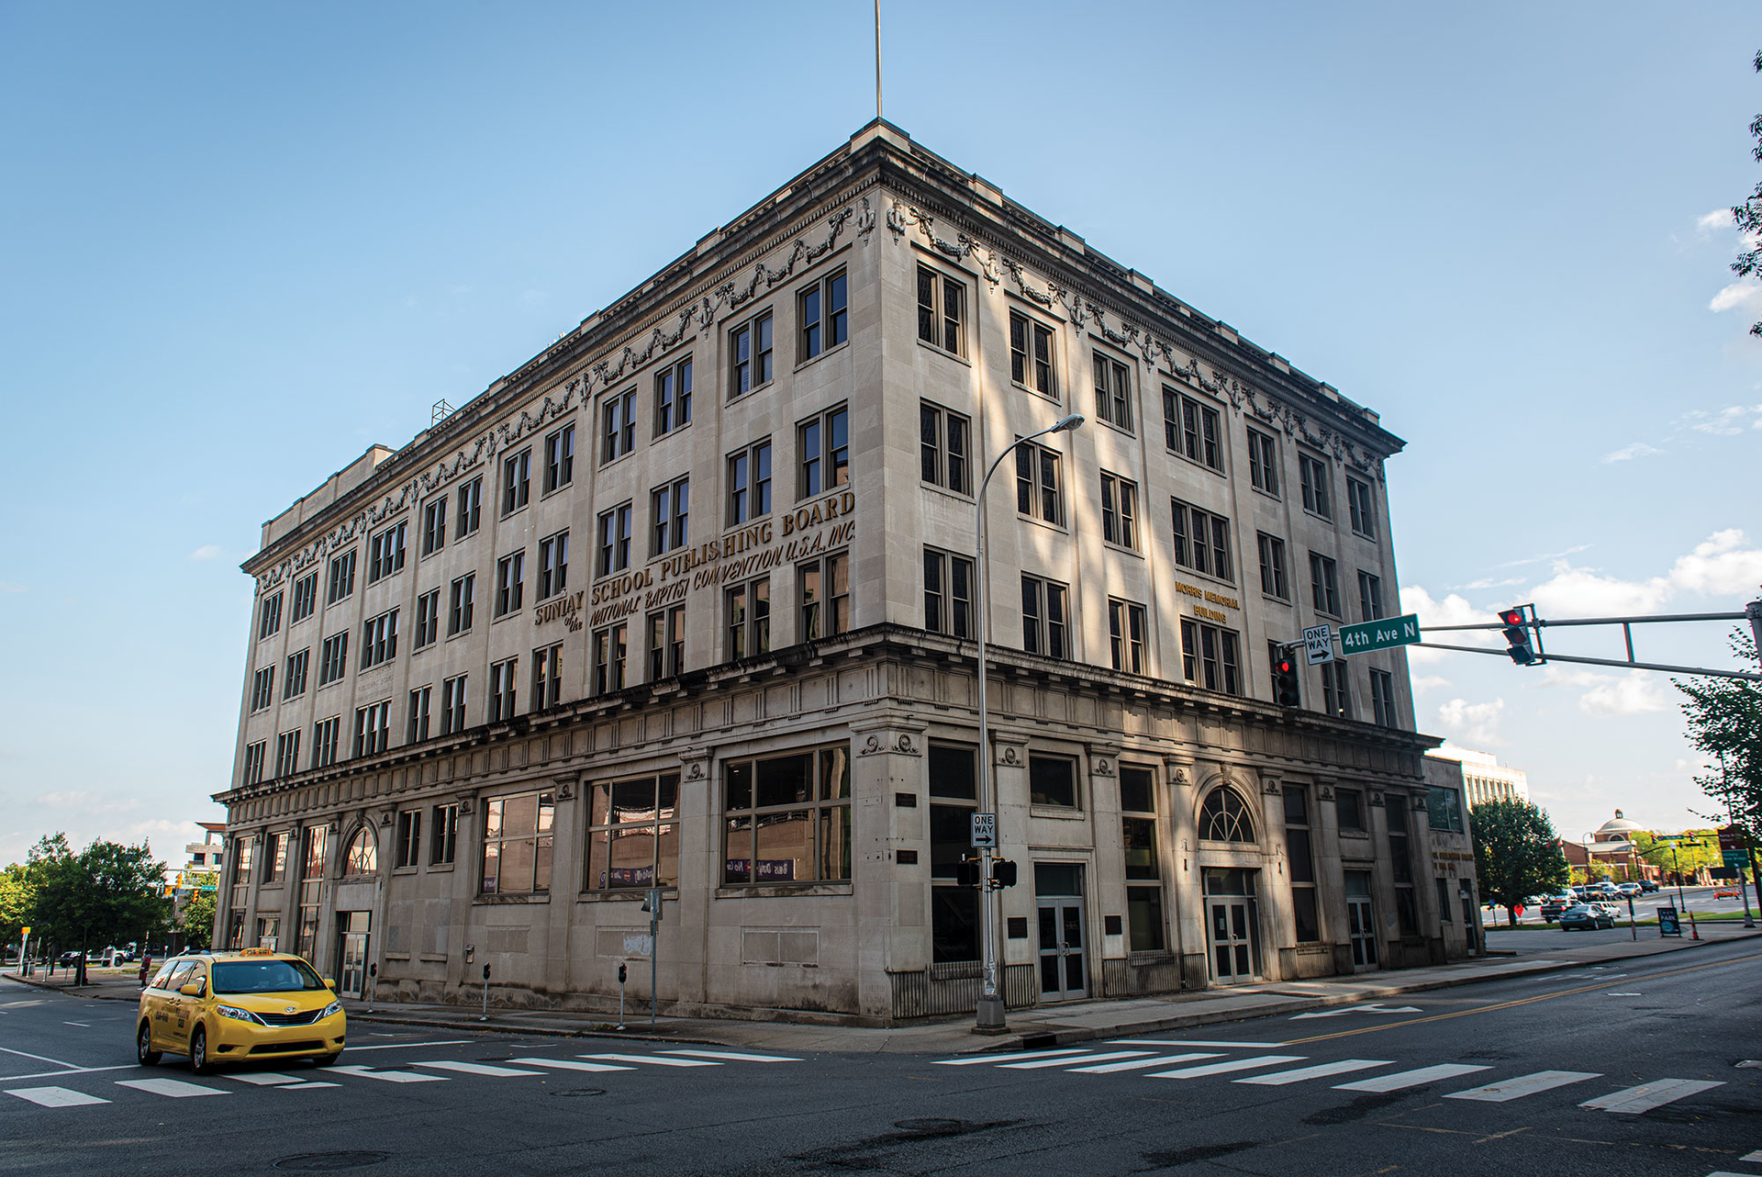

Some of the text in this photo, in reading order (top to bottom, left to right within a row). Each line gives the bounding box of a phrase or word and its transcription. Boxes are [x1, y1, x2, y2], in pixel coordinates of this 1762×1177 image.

[828, 520, 855, 548] INC.
[591, 568, 653, 606] SCHOOL
[660, 521, 772, 582] PUBLISHING
[781, 491, 855, 538] BOARD
[644, 578, 690, 609] BAPTIST
[1175, 581, 1240, 611] MORRIS MEMORIAL
[564, 611, 576, 626] of
[589, 595, 641, 627] NATIONAL
[1193, 604, 1227, 623] BUILDING
[569, 616, 583, 633] the
[1306, 627, 1328, 640] ONE
[1345, 621, 1415, 647] 4th Ave N
[1308, 638, 1329, 650] WAY
[974, 815, 993, 825] ONE
[974, 825, 993, 834] WAY
